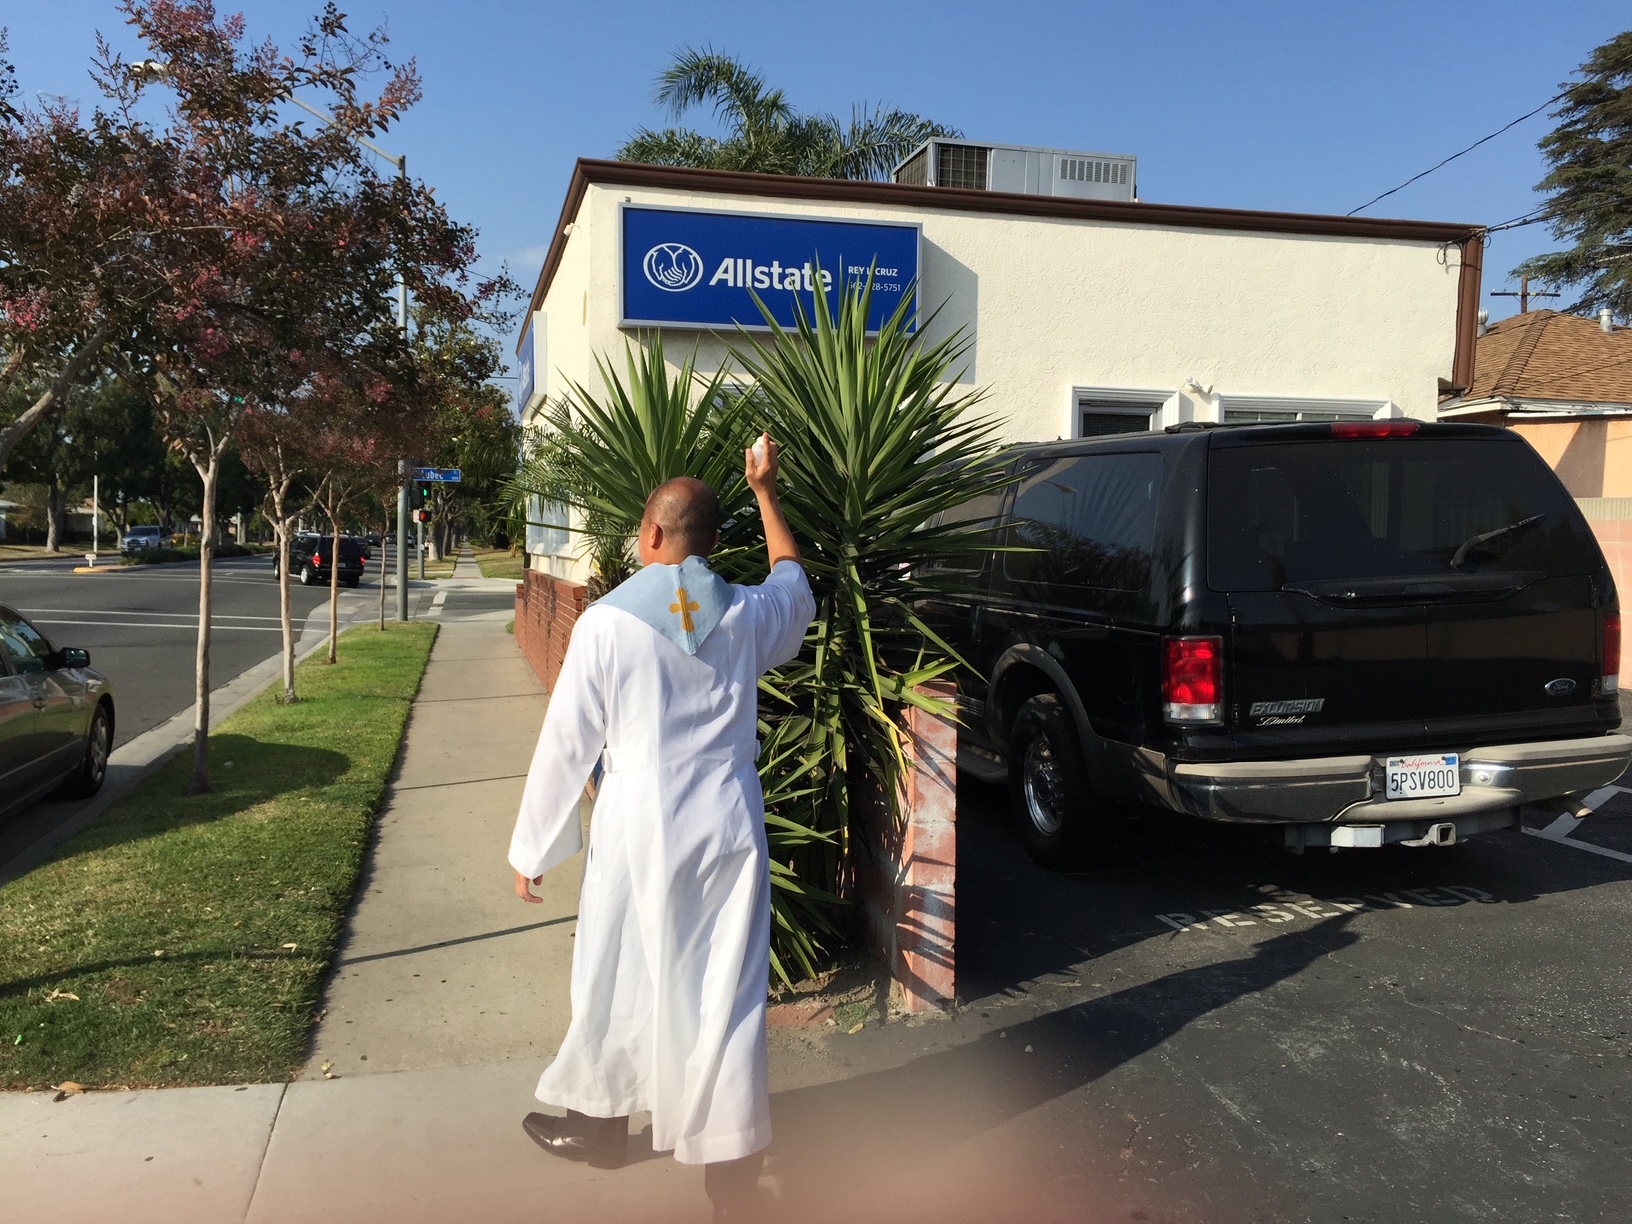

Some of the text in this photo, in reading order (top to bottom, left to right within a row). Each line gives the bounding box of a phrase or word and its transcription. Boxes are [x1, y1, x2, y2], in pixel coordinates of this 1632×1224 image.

[708, 257, 833, 292] Allstate
[848, 266, 865, 275] REY
[875, 267, 898, 277] CRUZ
[1249, 698, 1325, 716] EXCURSION
[1256, 715, 1306, 727] Limited
[1401, 758, 1445, 770] California
[1391, 769, 1454, 791] 5PSV800
[1154, 885, 1495, 932] RESERVED
